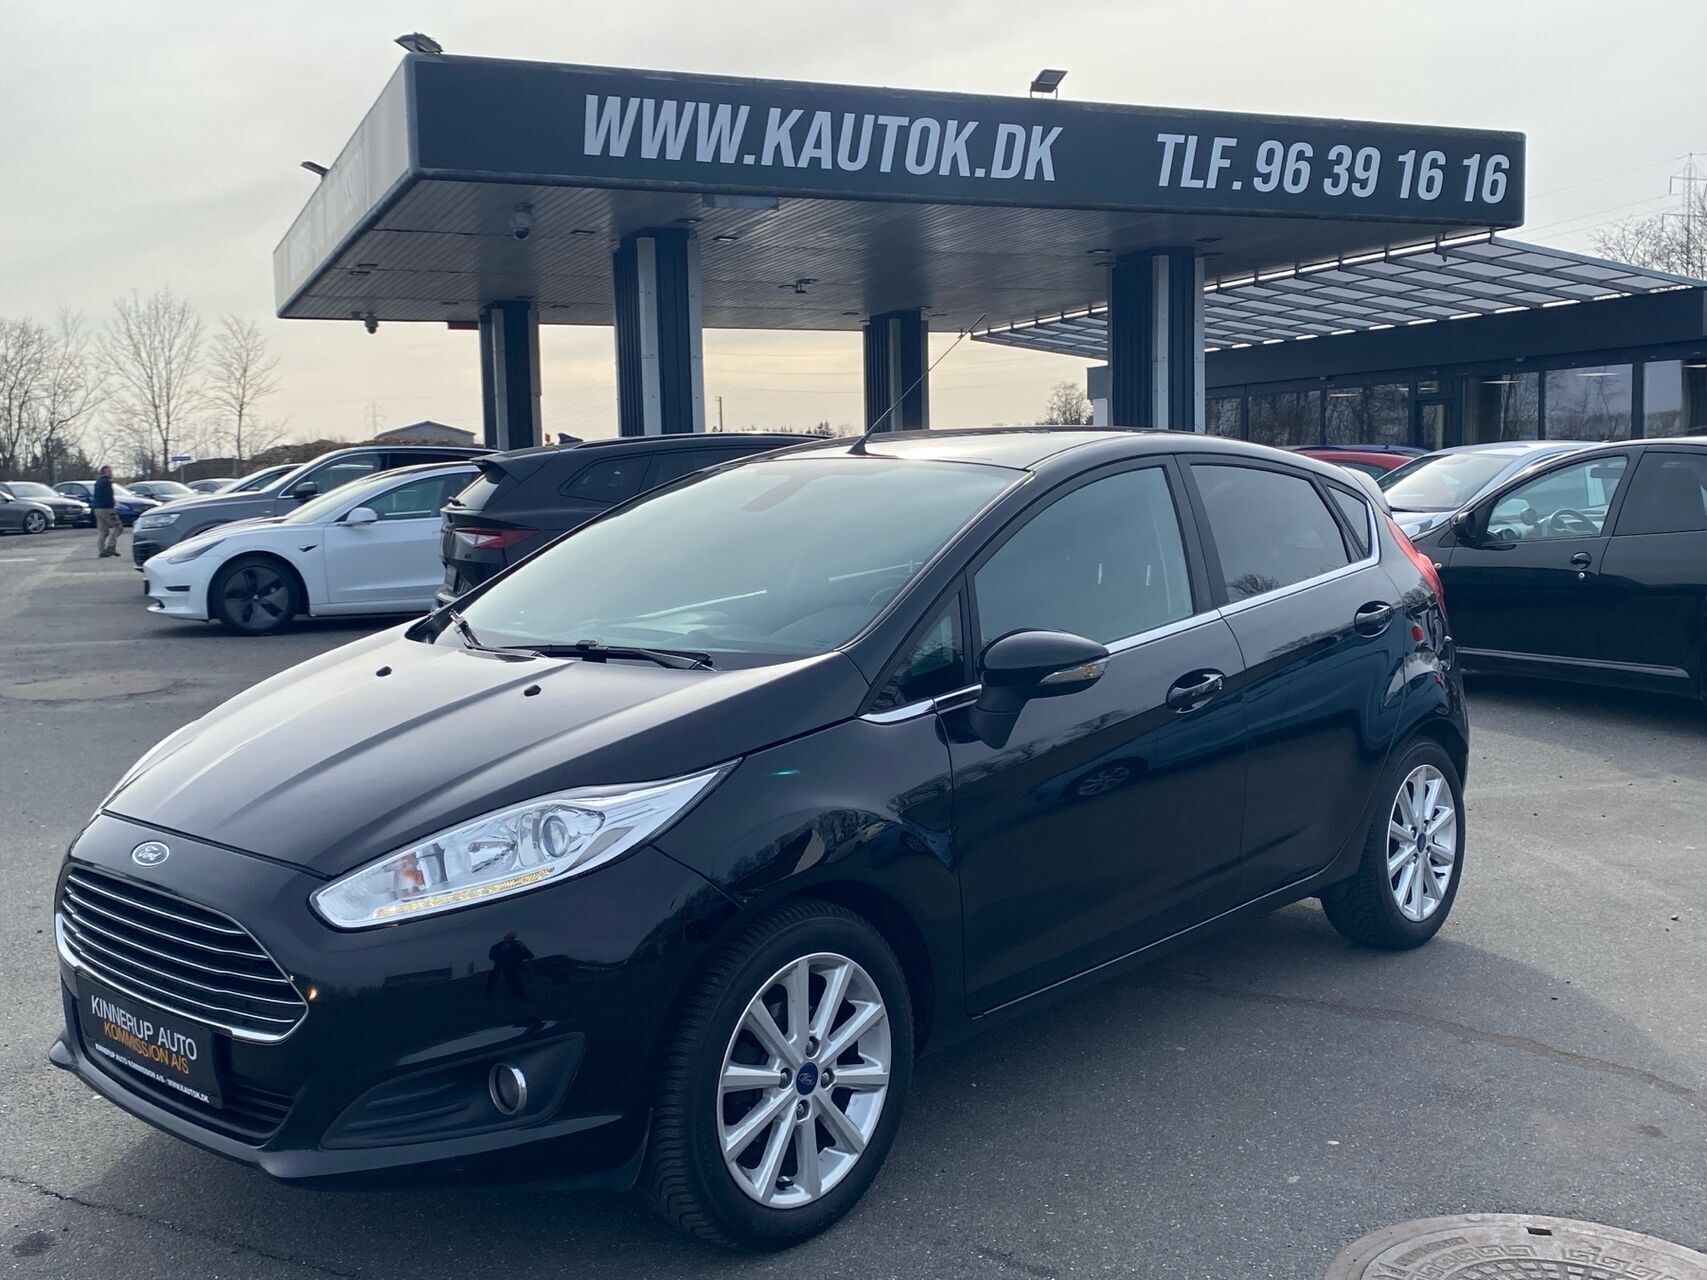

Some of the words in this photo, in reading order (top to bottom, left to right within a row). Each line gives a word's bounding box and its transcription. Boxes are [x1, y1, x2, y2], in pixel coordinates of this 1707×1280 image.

[584, 94, 1063, 182] WWW.KAUTOK.DK
[1157, 133, 1243, 191] TLF.
[1253, 139, 1314, 194] 96
[1323, 144, 1381, 198] 39
[1397, 149, 1447, 201] 16
[1462, 153, 1511, 204] 16
[91, 994, 154, 1041] KINNERUP
[158, 1026, 198, 1061] AUTO
[103, 1020, 170, 1066] KOMMISSION
[171, 1053, 190, 1074] A/S
